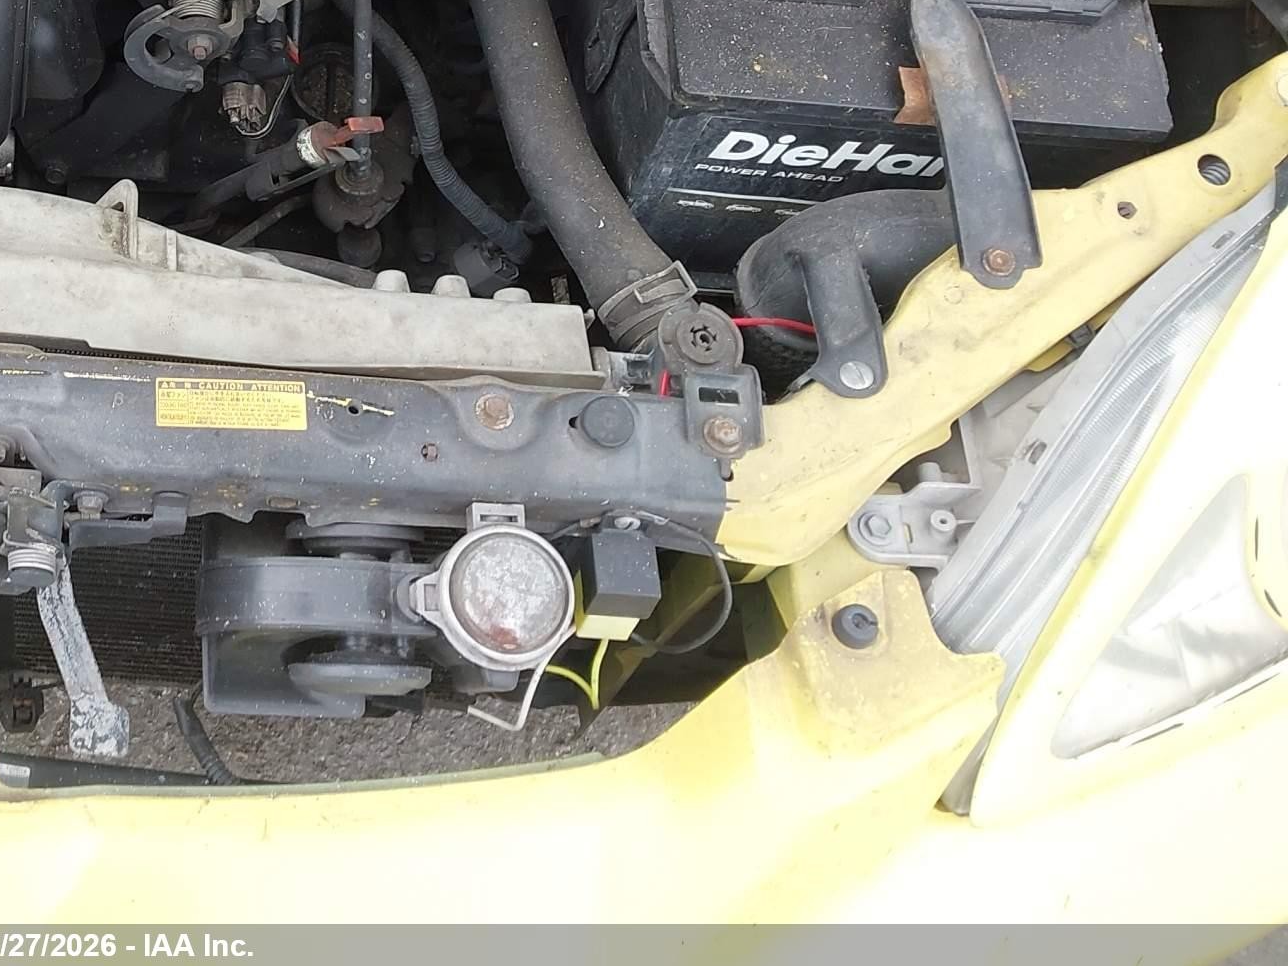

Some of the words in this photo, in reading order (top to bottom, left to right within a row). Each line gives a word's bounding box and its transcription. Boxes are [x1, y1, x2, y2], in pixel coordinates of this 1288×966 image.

[694, 164, 767, 177] POWER
[772, 170, 845, 183] AHEAD
[199, 382, 243, 391] CAUTION
[251, 382, 301, 393] ATTENTION
